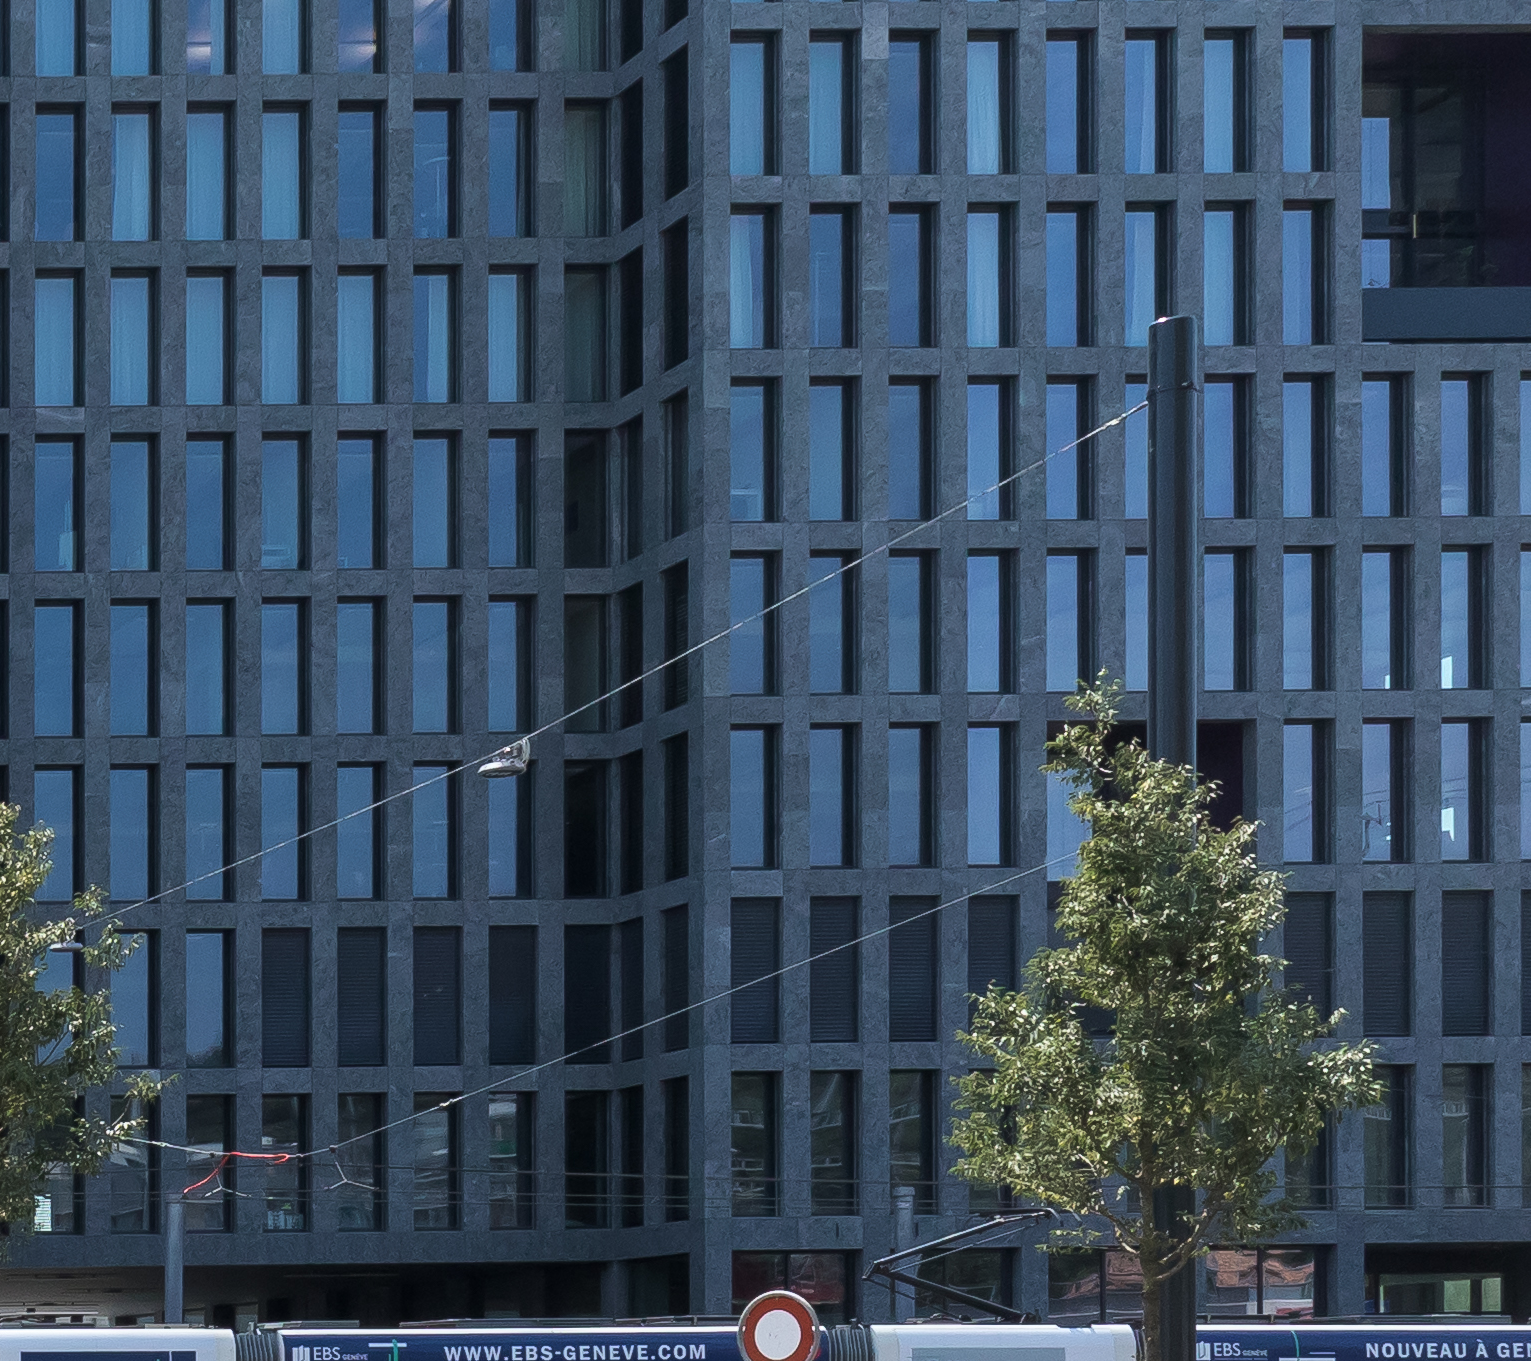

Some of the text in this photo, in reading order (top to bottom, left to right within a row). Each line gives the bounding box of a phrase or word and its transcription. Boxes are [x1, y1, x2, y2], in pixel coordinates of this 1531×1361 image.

[313, 1346, 341, 1361] EBS
[444, 1344, 707, 1361] WWW.EBS-GENEVE.COM
[1213, 1342, 1242, 1357] EBS
[1365, 1342, 1467, 1359] NOUVEAU
[1475, 1338, 1490, 1359] À
